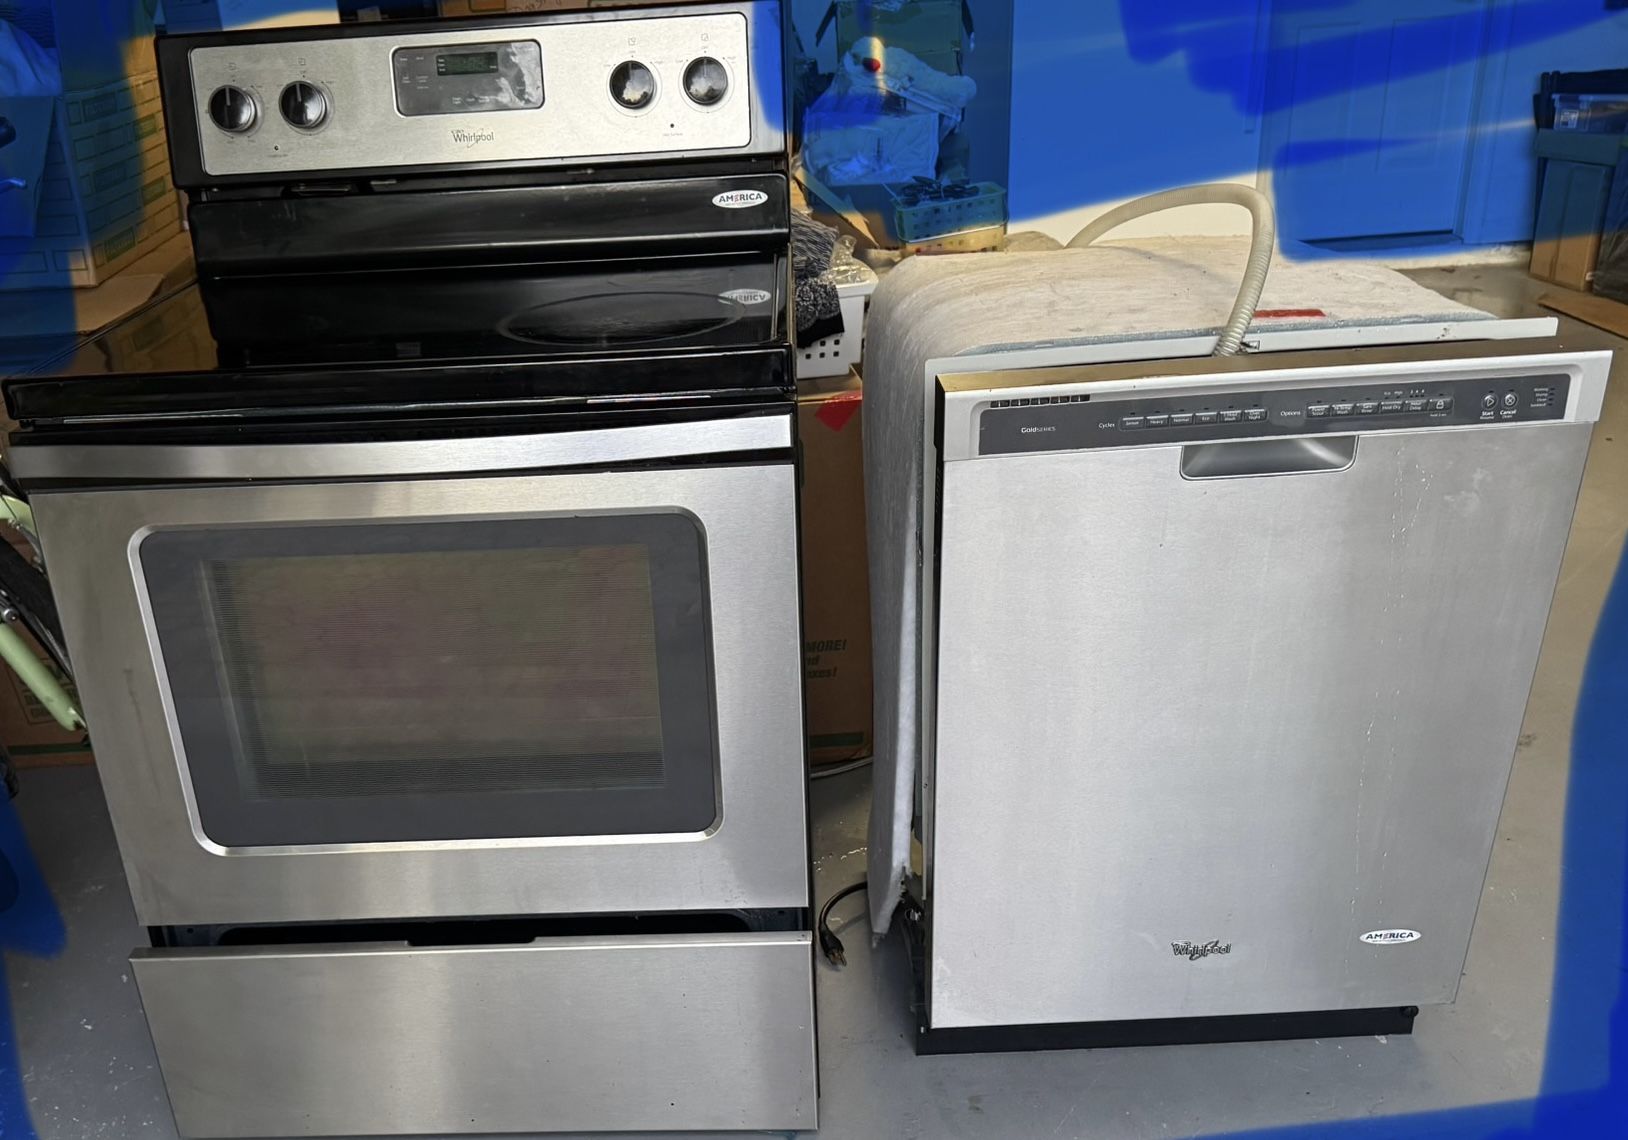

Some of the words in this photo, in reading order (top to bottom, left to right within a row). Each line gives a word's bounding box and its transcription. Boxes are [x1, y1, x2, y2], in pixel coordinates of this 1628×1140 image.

[451, 129, 494, 146] Whirlpool
[719, 193, 762, 203] AMERICA
[1366, 932, 1414, 940] AMERICA
[1171, 940, 1231, 960] Whirlpool
